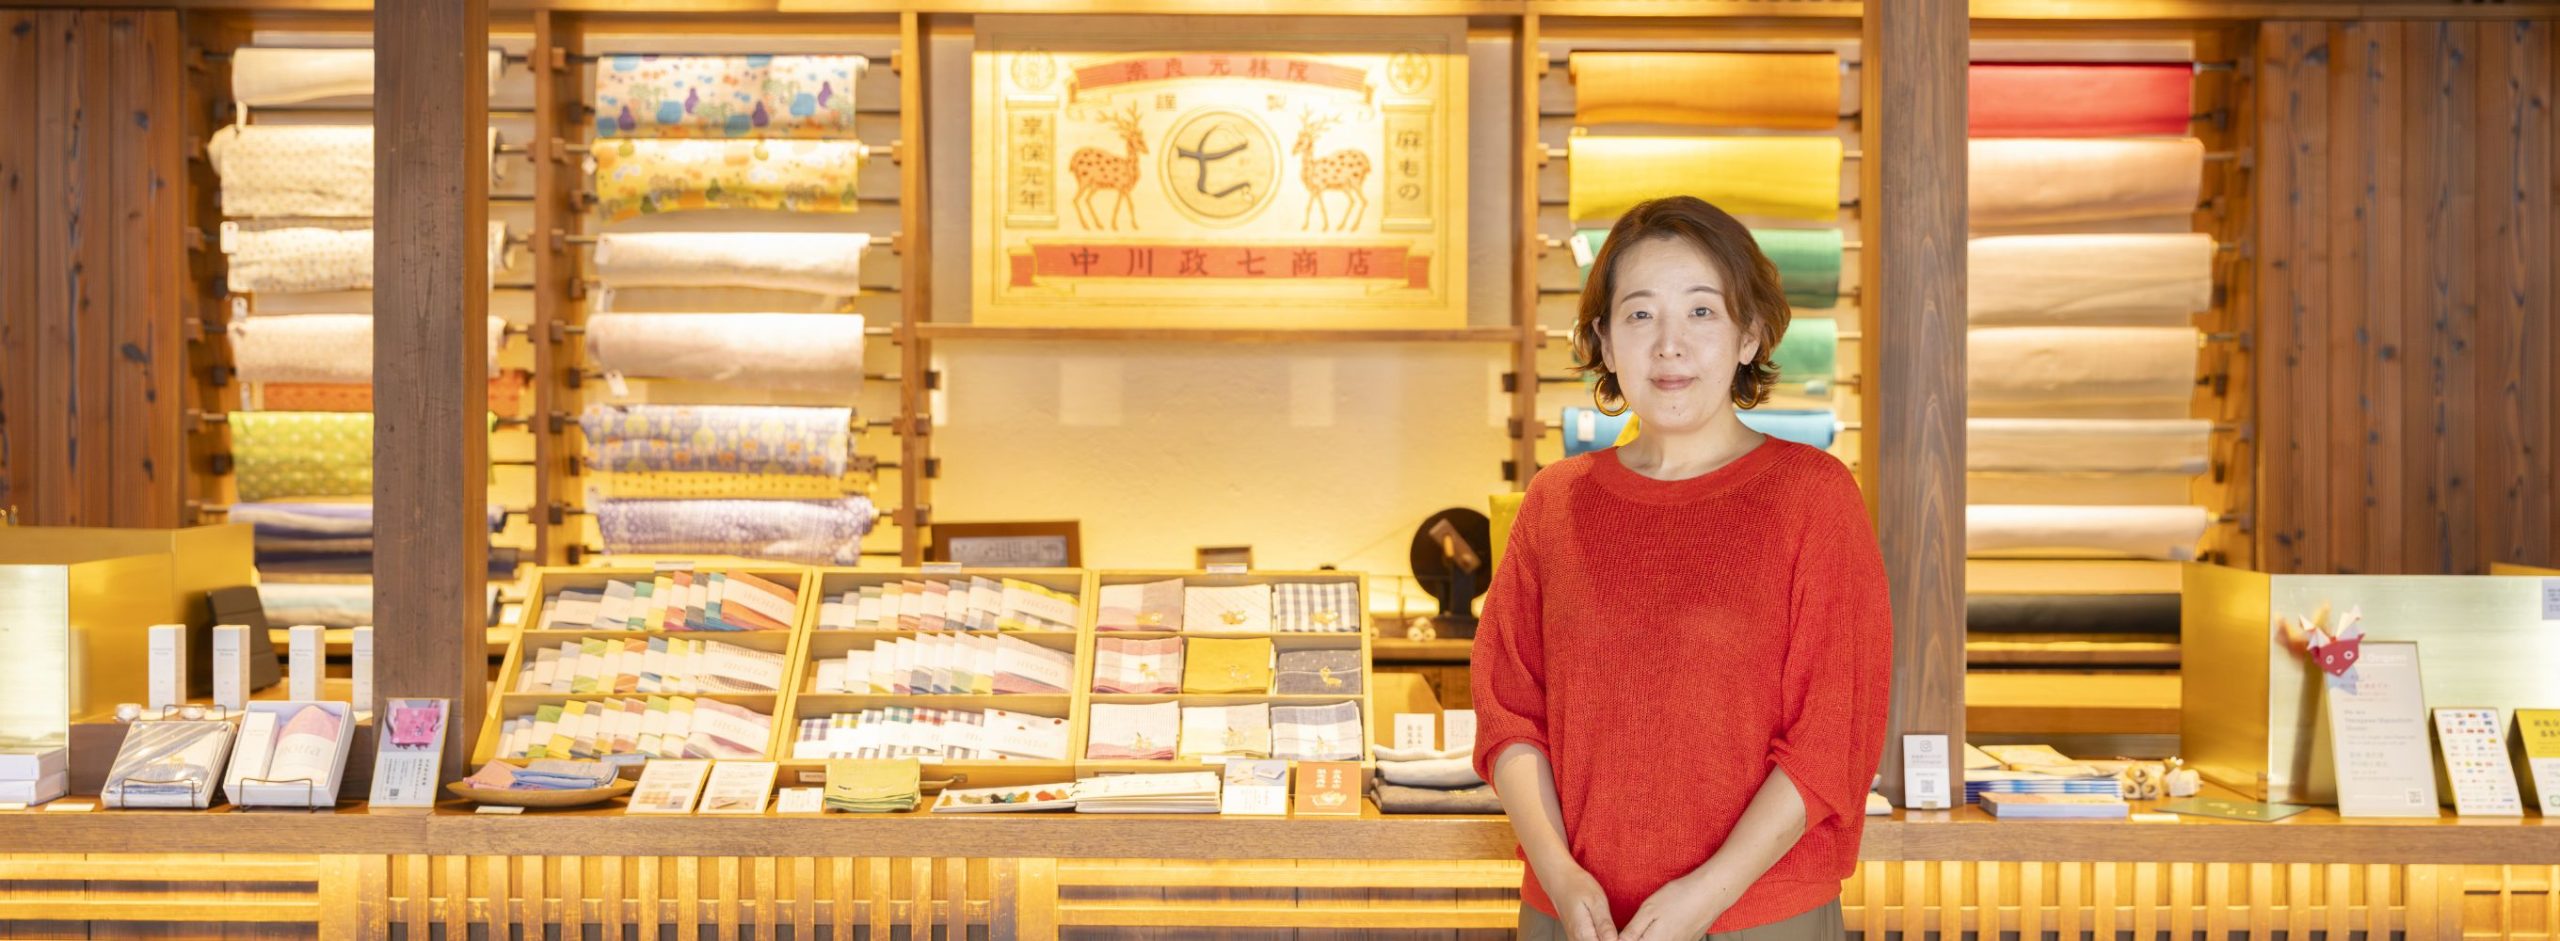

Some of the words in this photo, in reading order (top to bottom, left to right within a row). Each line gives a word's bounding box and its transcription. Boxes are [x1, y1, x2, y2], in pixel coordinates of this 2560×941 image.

[1020, 116, 1045, 209] 享保元年
[1395, 130, 1422, 201] 麻もの
[1071, 247, 1372, 277] 中川政七商店
